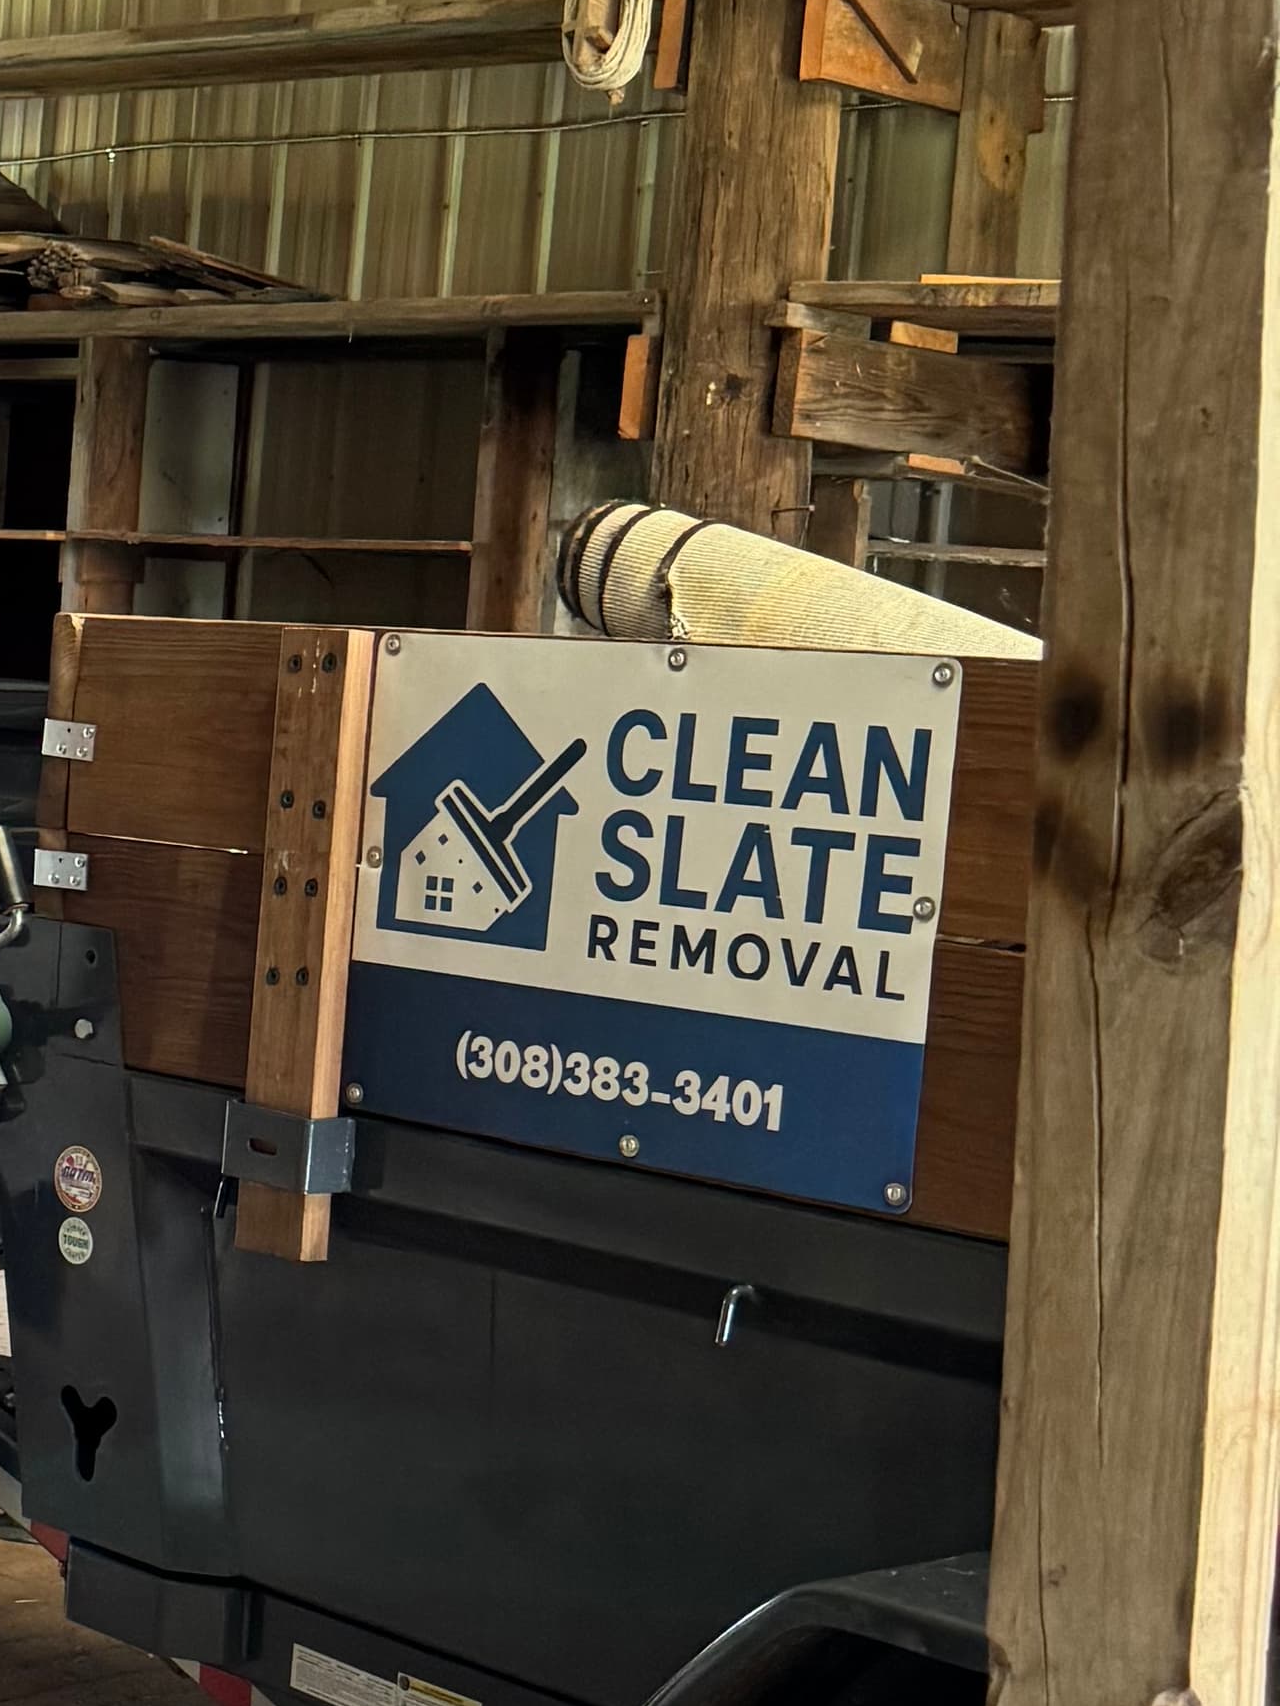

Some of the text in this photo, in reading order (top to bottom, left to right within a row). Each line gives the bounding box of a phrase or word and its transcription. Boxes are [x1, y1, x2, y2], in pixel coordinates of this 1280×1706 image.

[606, 709, 933, 822] CLEAN
[594, 808, 922, 935] SLATE
[587, 914, 906, 1001] REMOVAL
[455, 1029, 785, 1133] (308)383-3401
